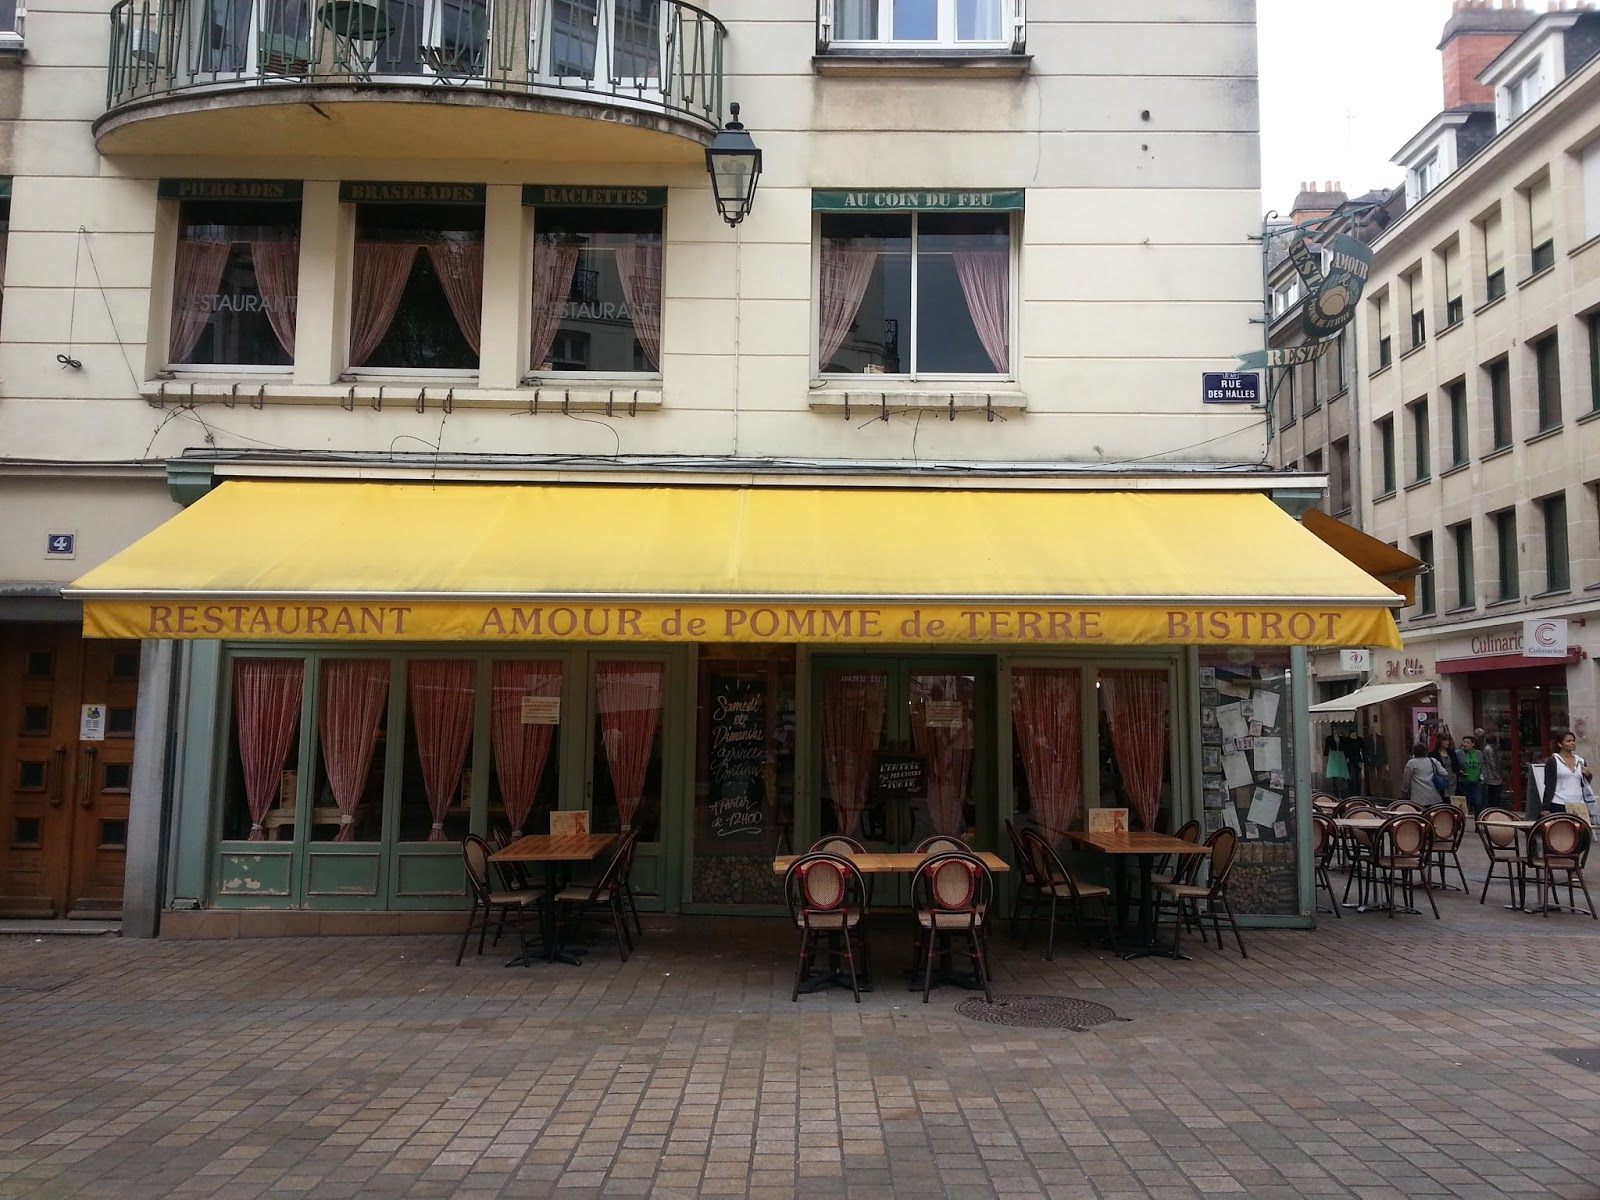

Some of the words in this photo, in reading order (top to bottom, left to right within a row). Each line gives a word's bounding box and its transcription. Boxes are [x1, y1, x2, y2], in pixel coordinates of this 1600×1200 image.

[543, 188, 648, 204] RACLETTES
[844, 193, 869, 206] AU
[874, 192, 919, 207] COIN
[926, 193, 950, 206] DU
[957, 193, 993, 206] FEU
[1332, 252, 1369, 280] AMOUR
[1208, 390, 1223, 398] DES
[1226, 390, 1255, 398] HALLES
[1221, 380, 1242, 388] RUE
[53, 536, 67, 550] 4
[149, 605, 412, 634] RESTAURANT
[479, 606, 643, 636] AMOUR
[661, 609, 706, 637] de
[724, 608, 882, 637] POMME
[900, 610, 945, 638] de
[961, 611, 1103, 639] TERRE
[1167, 611, 1342, 640] BISTROT
[713, 693, 761, 721] Samedi
[712, 724, 764, 749] Dimanche
[726, 812, 762, 827] 12H00
